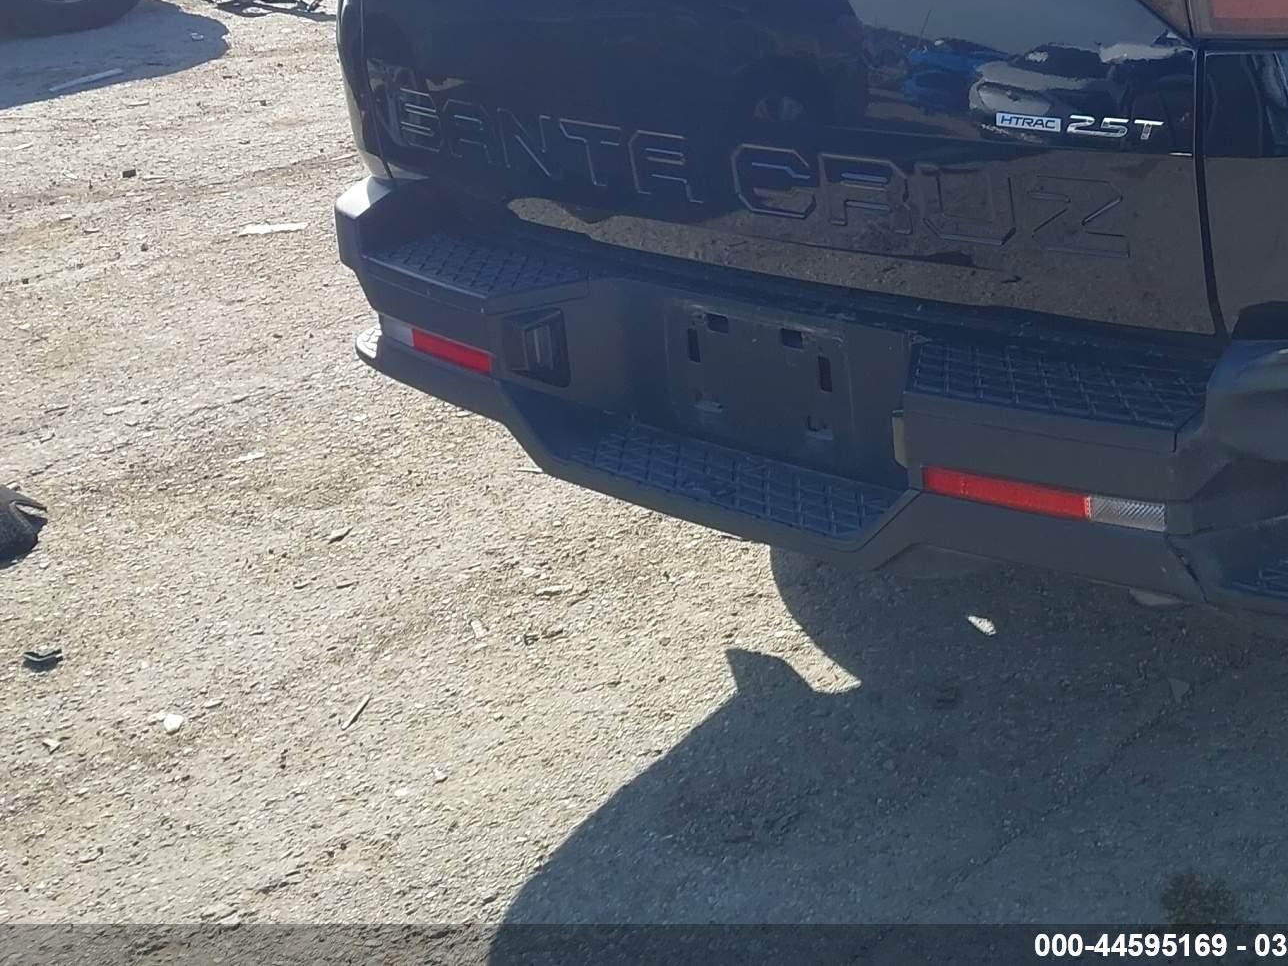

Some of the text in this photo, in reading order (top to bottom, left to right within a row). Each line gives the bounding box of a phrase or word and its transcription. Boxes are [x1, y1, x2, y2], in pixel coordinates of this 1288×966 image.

[1000, 115, 1056, 130] HTRAC
[397, 87, 1131, 259] SANTA CRUZ
